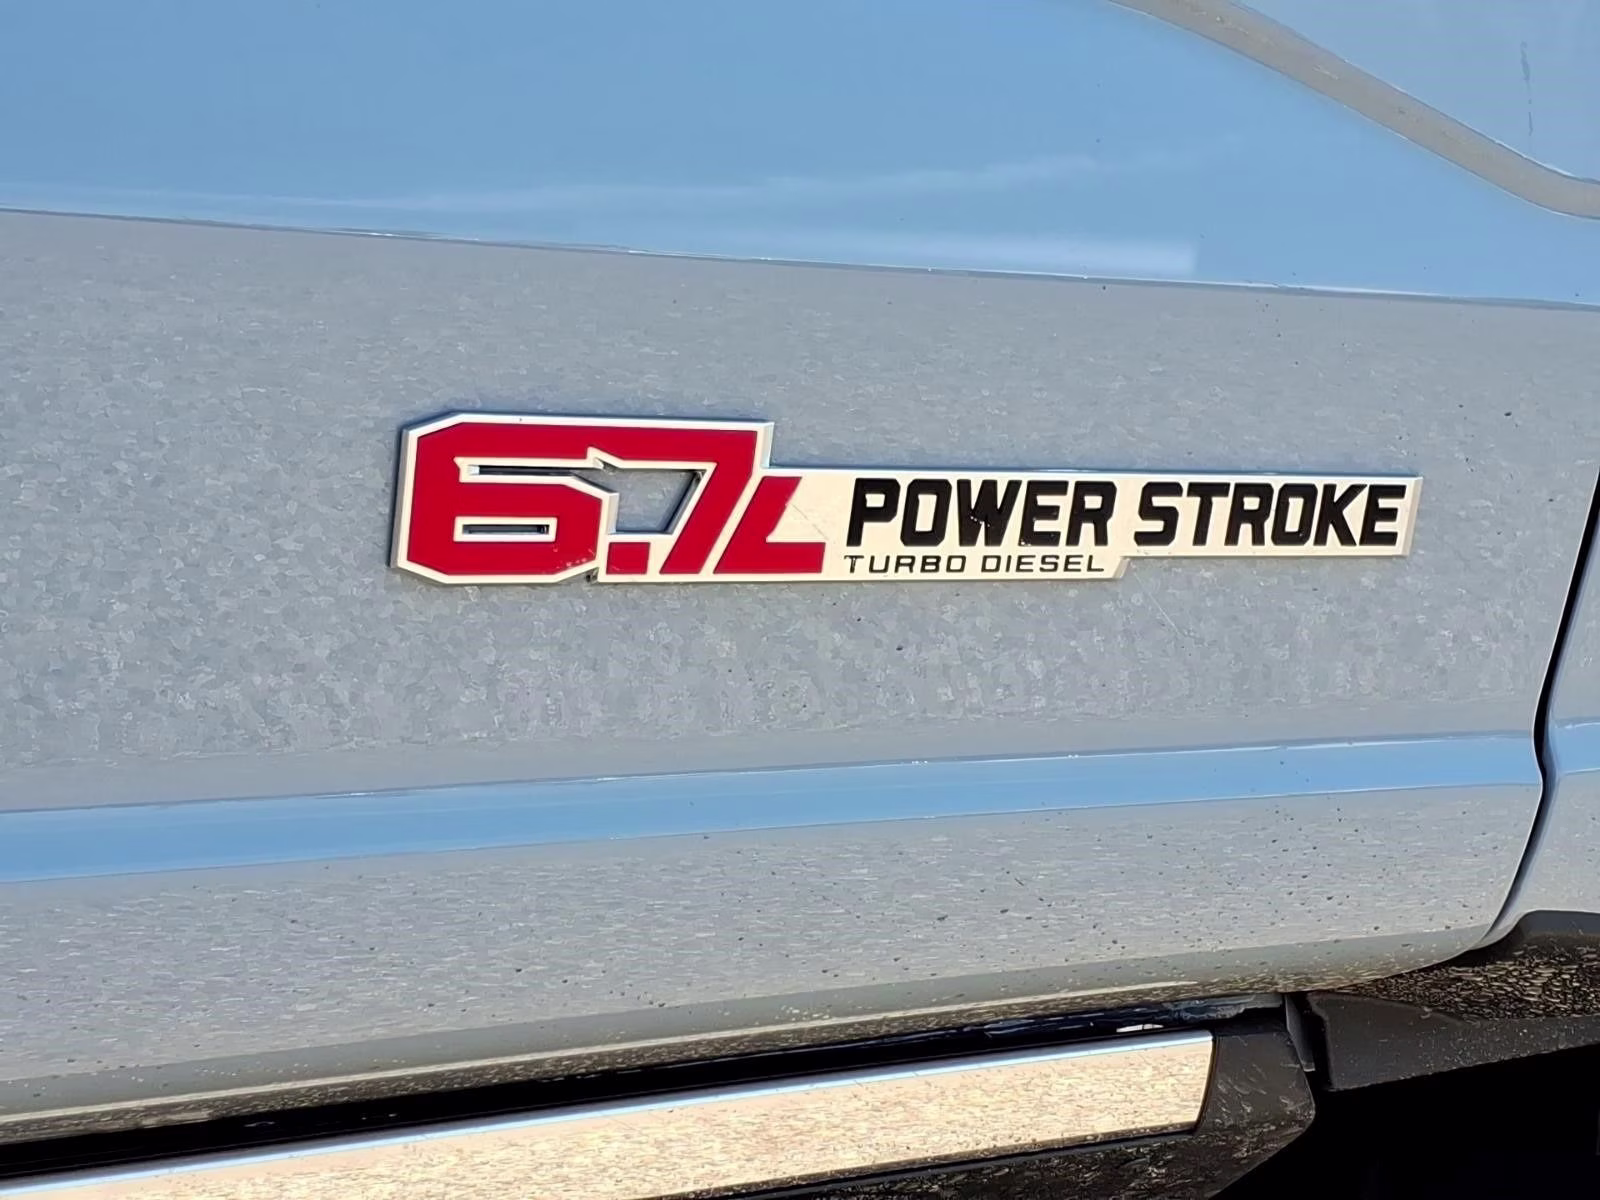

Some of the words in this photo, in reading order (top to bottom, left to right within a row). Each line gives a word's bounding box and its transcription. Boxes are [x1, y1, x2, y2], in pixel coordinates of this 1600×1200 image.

[407, 422, 826, 575] 6.7L
[846, 478, 1117, 547] POWER
[1133, 481, 1407, 547] STROKE
[844, 554, 967, 574] TURBO
[980, 554, 1105, 573] DIESEL
